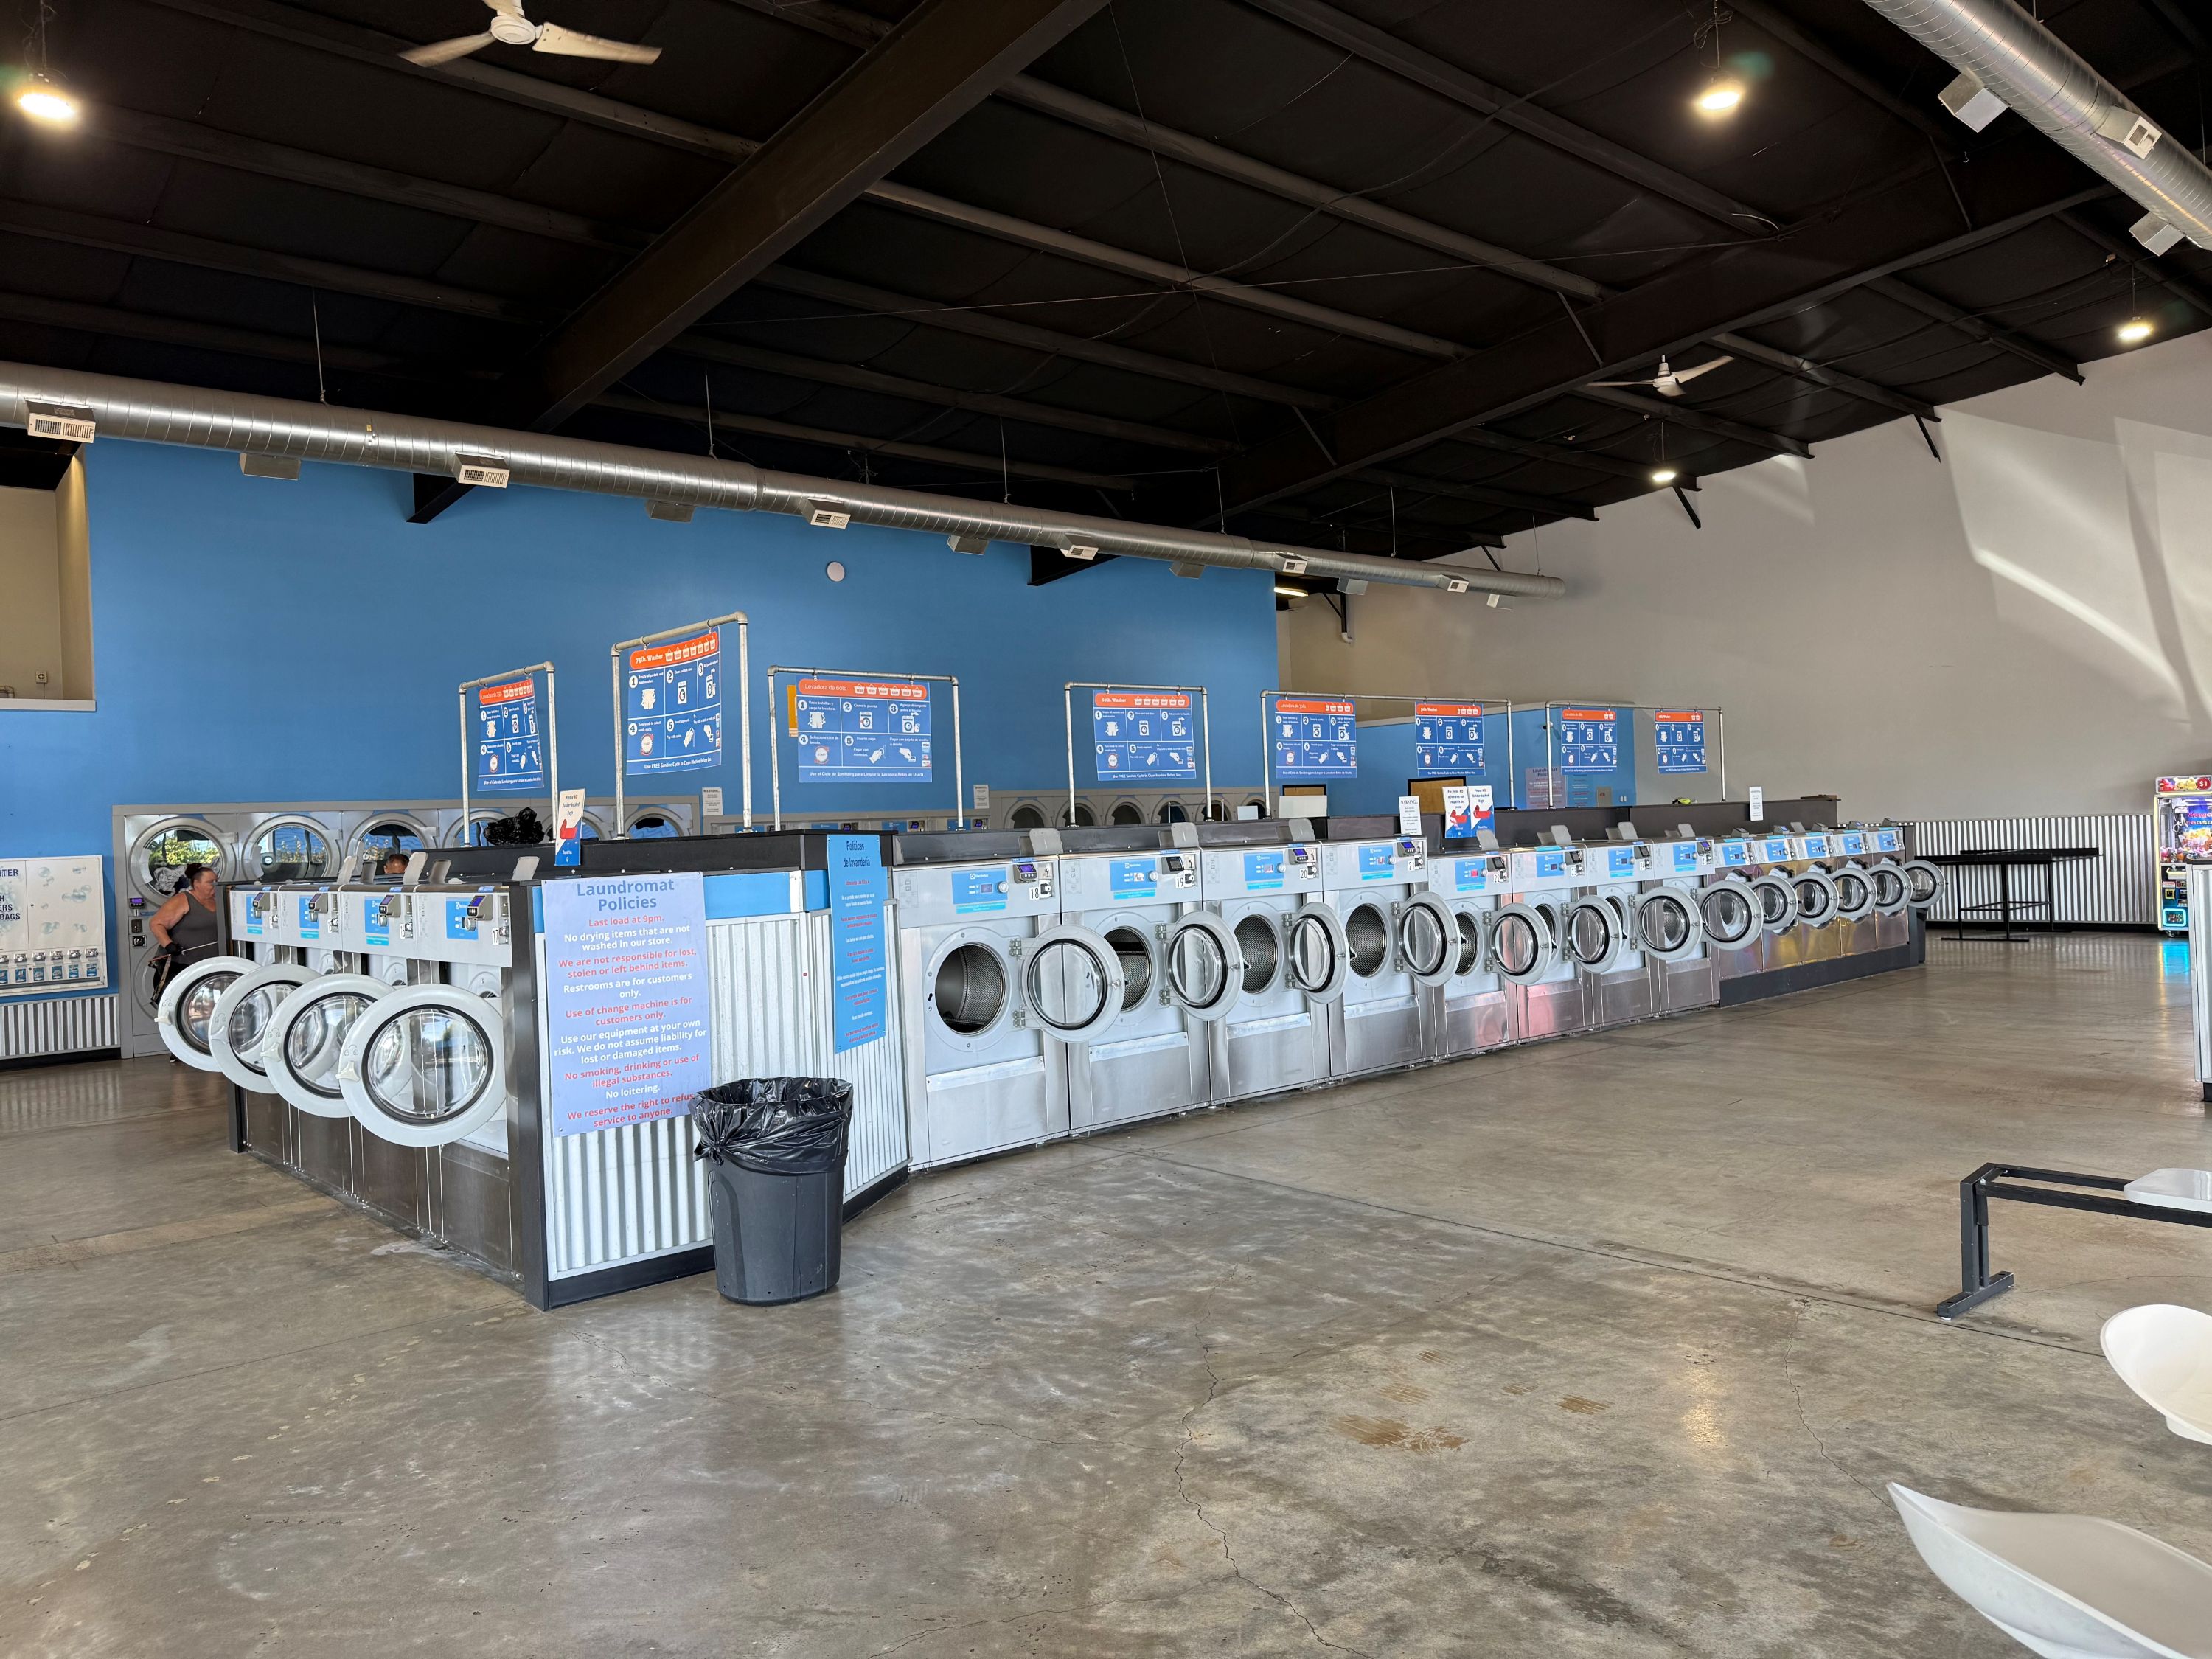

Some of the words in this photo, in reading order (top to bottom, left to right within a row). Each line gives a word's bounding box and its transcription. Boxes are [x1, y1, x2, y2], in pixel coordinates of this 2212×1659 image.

[843, 858, 849, 867] de
[0, 869, 18, 877] TER
[1301, 870, 1307, 879] 20
[577, 879, 675, 896] Laundromat
[1177, 877, 1183, 887] 19
[1030, 888, 1039, 899] 18
[599, 896, 656, 911] Policies
[589, 918, 608, 927] Last
[611, 917, 629, 925] load
[643, 915, 664, 924] 9pm.
[580, 931, 610, 942] drying
[612, 930, 636, 938] items
[639, 927, 657, 936] that
[582, 941, 617, 951] washed
[620, 939, 628, 947] in
[648, 936, 672, 945] store.
[612, 951, 662, 964] responsible
[664, 950, 677, 958] for
[568, 968, 597, 978] stolen
[612, 965, 627, 973] left
[630, 961, 659, 972] behind
[662, 959, 687, 968] items.
[564, 980, 613, 992] Restrooms
[633, 976, 645, 985] for
[647, 973, 692, 984] customers
[619, 989, 641, 998] only.
[566, 1009, 582, 1018] Use
[597, 1004, 629, 1015] change
[632, 1000, 669, 1010] machine
[596, 1015, 642, 1026] customers
[645, 1010, 665, 1020] only.
[561, 1035, 578, 1043] Use
[581, 1034, 596, 1042] our
[599, 1026, 647, 1040] equipment
[661, 1023, 681, 1032] your
[554, 1046, 574, 1056] risk.
[577, 1045, 591, 1053] We
[625, 1037, 658, 1046] assume
[661, 1032, 692, 1042] liability
[581, 1055, 598, 1064] lost
[613, 1048, 653, 1059] damaged
[655, 1045, 681, 1053] items.
[565, 1072, 578, 1080] No
[581, 1066, 621, 1078] smoking,
[625, 1060, 661, 1071] drinking
[593, 1077, 619, 1088] illegal
[622, 1071, 672, 1083] substances.
[606, 1091, 618, 1099] No
[621, 1085, 660, 1096] loitering.
[568, 1112, 582, 1120] We
[585, 1107, 618, 1117] reserve
[621, 1103, 636, 1112] the
[638, 1098, 658, 1109] right
[672, 1093, 694, 1102] refus
[594, 1117, 625, 1127] service
[639, 1109, 672, 1120] anyone.
